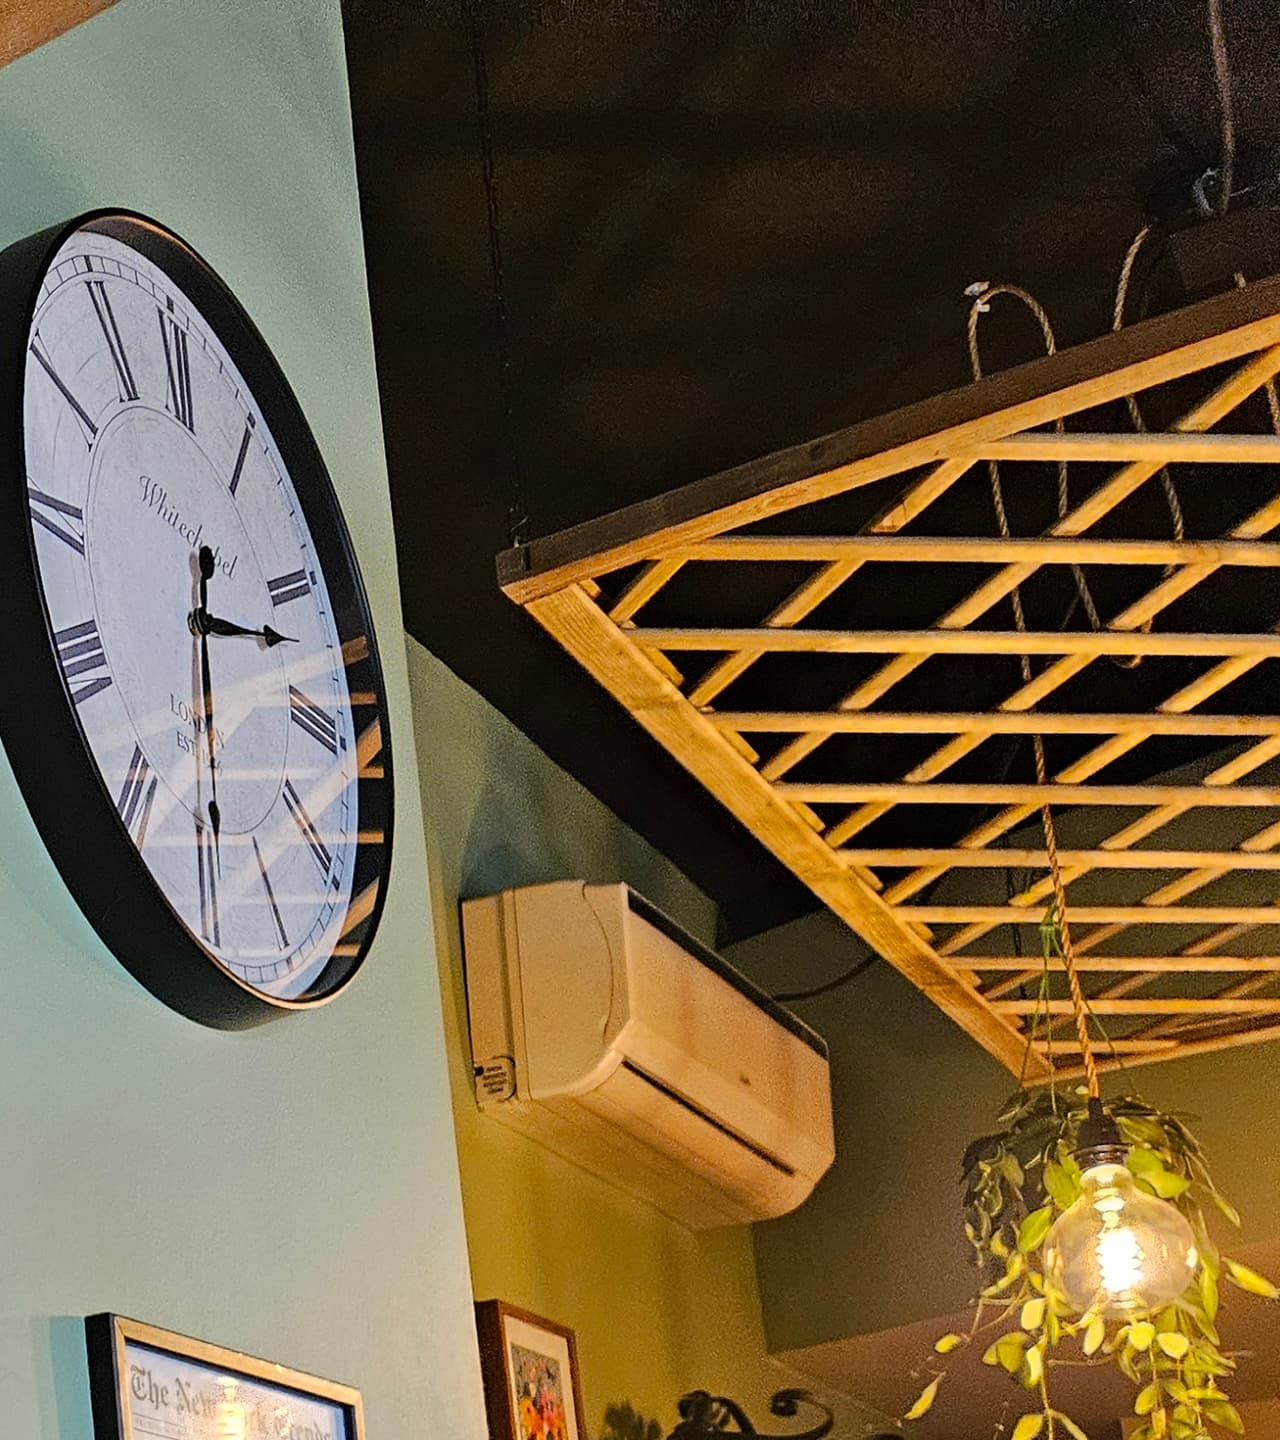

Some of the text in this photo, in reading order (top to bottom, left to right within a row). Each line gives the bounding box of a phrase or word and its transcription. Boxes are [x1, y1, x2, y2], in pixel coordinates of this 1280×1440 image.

[139, 475, 238, 581] Whitechpel
[170, 693, 225, 750] LONDN
[130, 1364, 169, 1411] The
